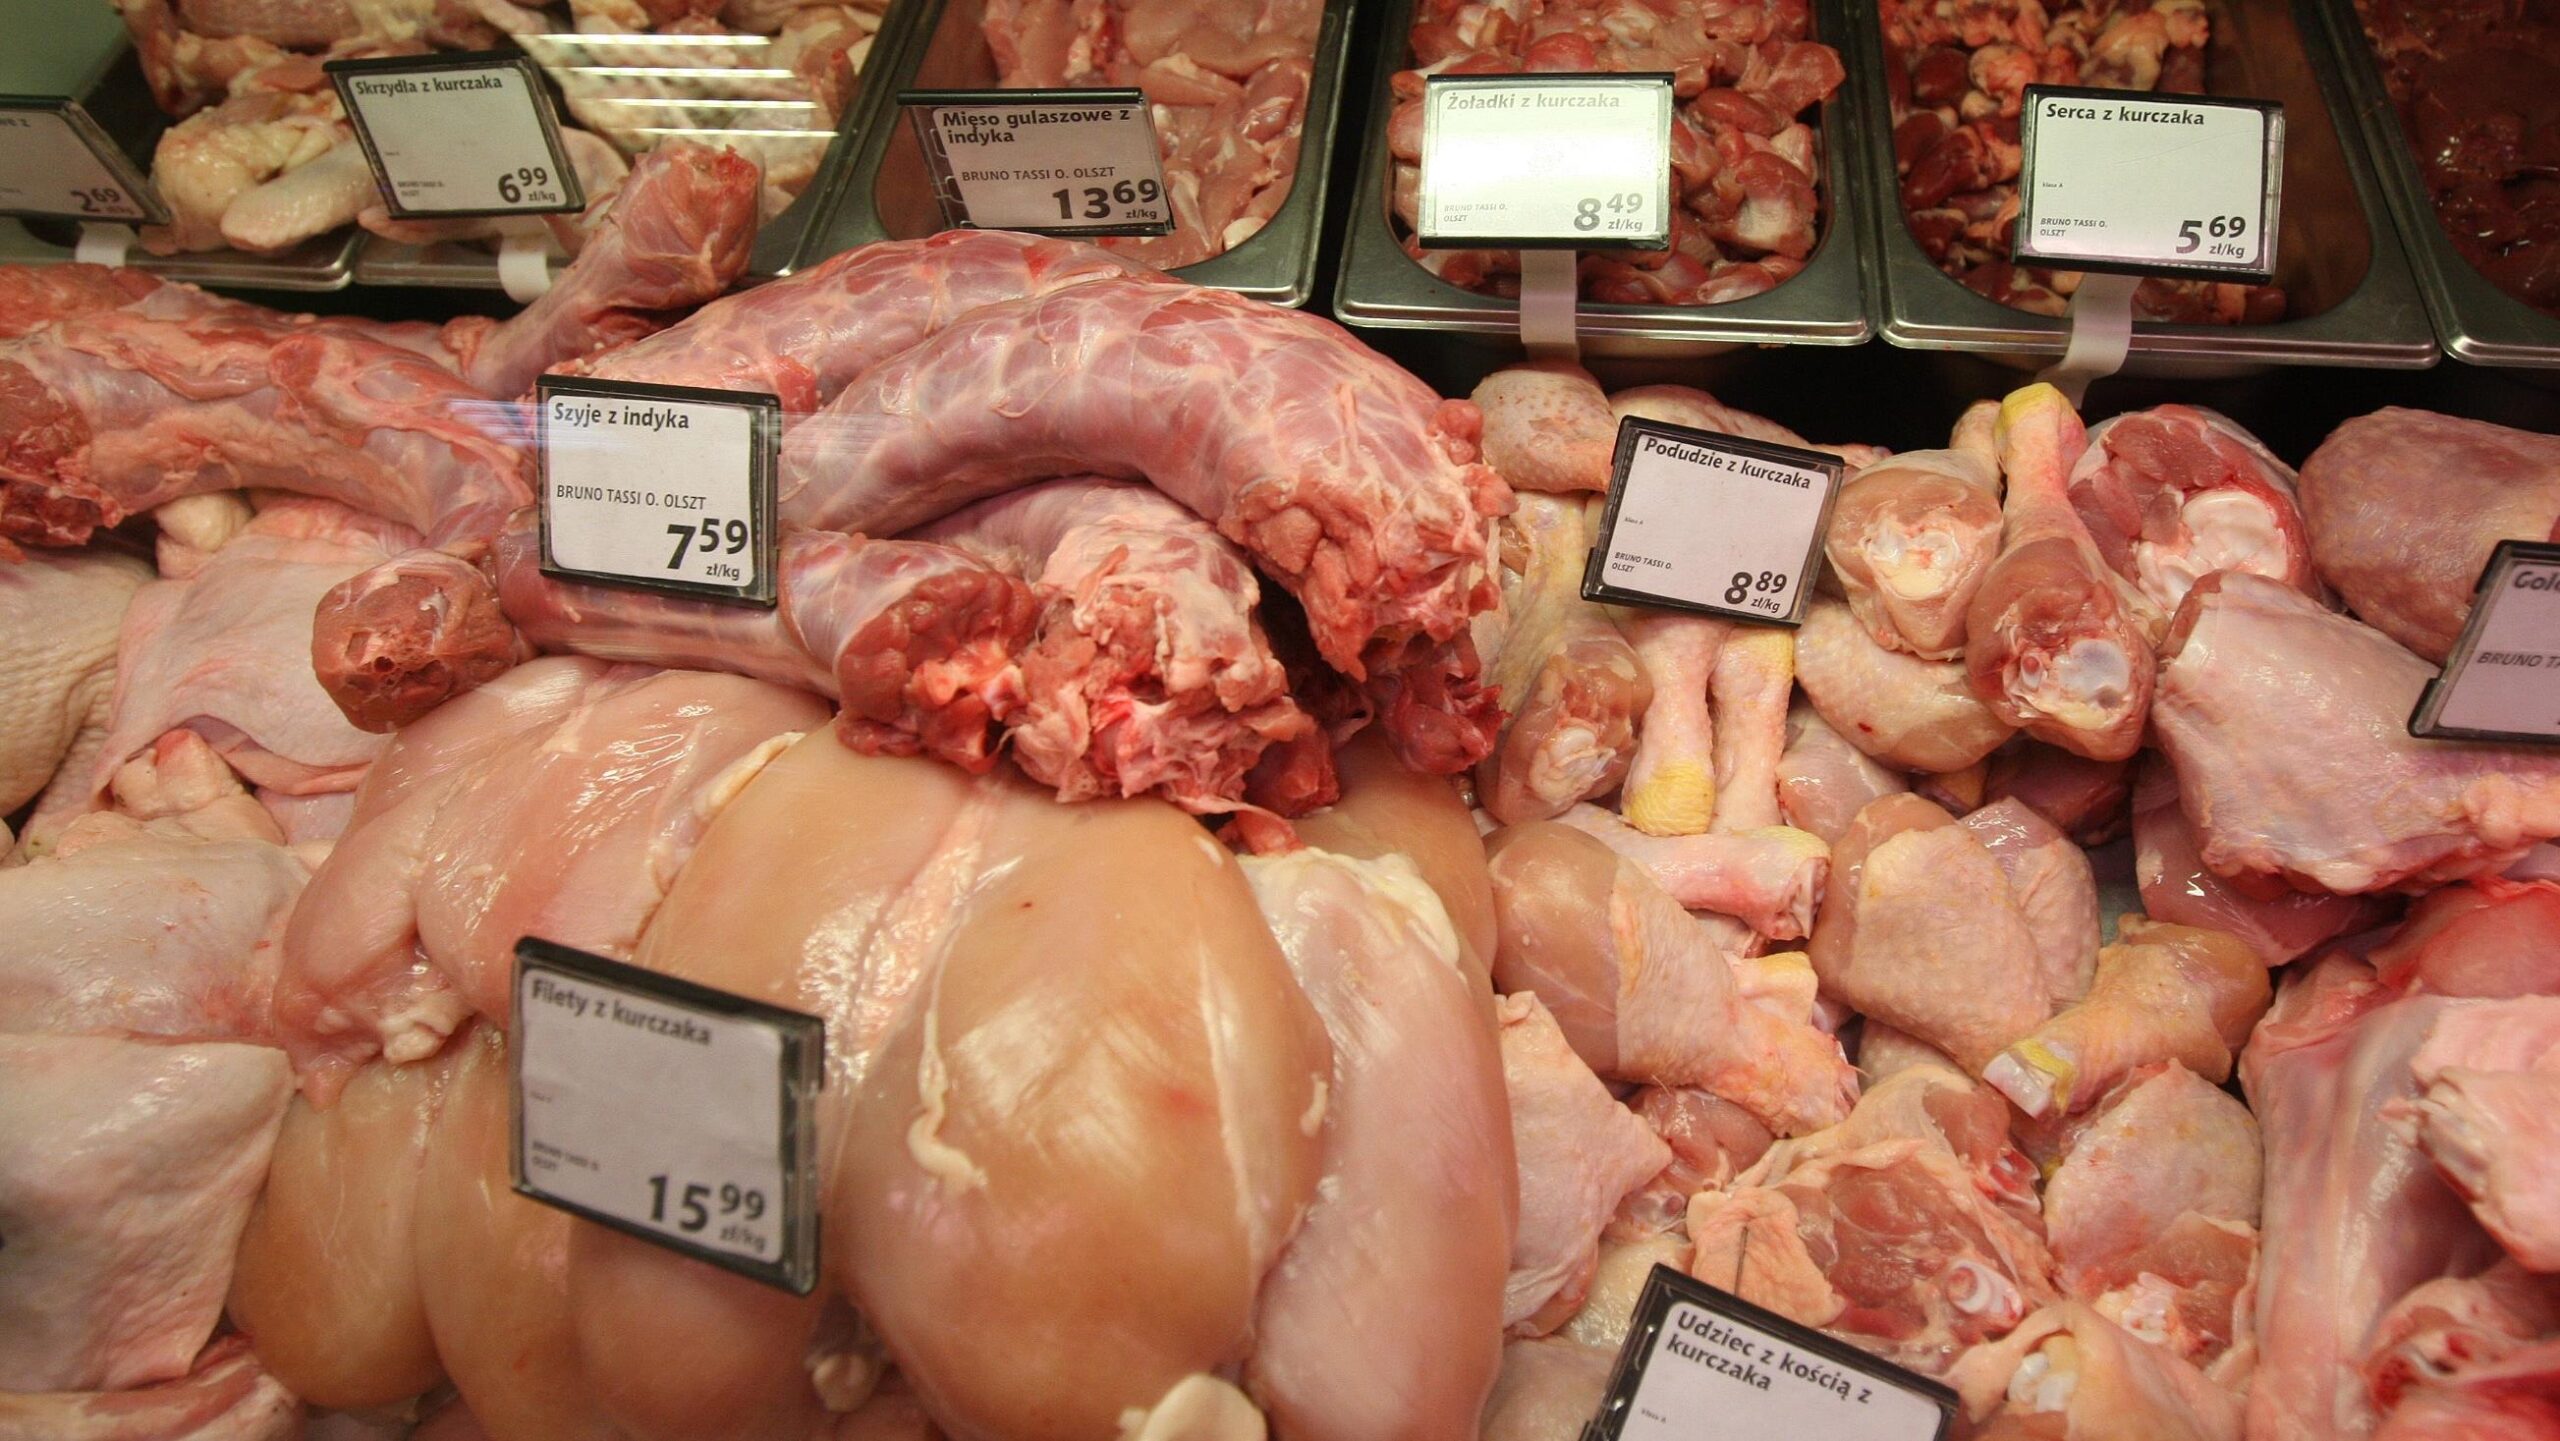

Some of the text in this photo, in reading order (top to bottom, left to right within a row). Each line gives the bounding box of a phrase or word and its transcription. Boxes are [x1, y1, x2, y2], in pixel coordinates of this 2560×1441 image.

[355, 75, 503, 97] Skrzydła z kurczaka
[1520, 97, 1530, 108] z
[1537, 93, 1620, 108] kurczaka
[943, 109, 1130, 129] Mięso gulaszowe z
[2046, 103, 2205, 125] Serca z kurczaka
[948, 128, 1015, 146] indyka
[962, 166, 1116, 182] BRUNO TASSI O. OLSZT
[1125, 208, 1158, 220] zł/kg
[1444, 204, 1472, 212] BRUNO
[1475, 203, 1497, 212] TASSI
[1443, 214, 1468, 223] OLSZT
[1607, 218, 1643, 232] zł/kg
[2040, 217, 2071, 227] BRUNO
[2073, 219, 2097, 228] TASSI
[2040, 229, 2066, 238] OLSZT
[2208, 243, 2245, 259] zł/kg
[554, 402, 689, 431] Szyje z indyka
[1644, 437, 1811, 490] Podudzie z kurczaka
[557, 484, 707, 510] BRUNO TASSI O. OLSZT
[1611, 562, 1635, 573] OLSZT
[1614, 552, 1642, 563] BRUNO
[1643, 557, 1665, 569] TASSI
[705, 563, 740, 581] zł/kg
[1750, 596, 1781, 614] zł/kg
[2477, 652, 2543, 668] BRUNO
[532, 978, 712, 1046] Filety z kurczaka
[1666, 1333, 1772, 1391] kurczaka
[1677, 1310, 1873, 1405] Udziec z kością z
